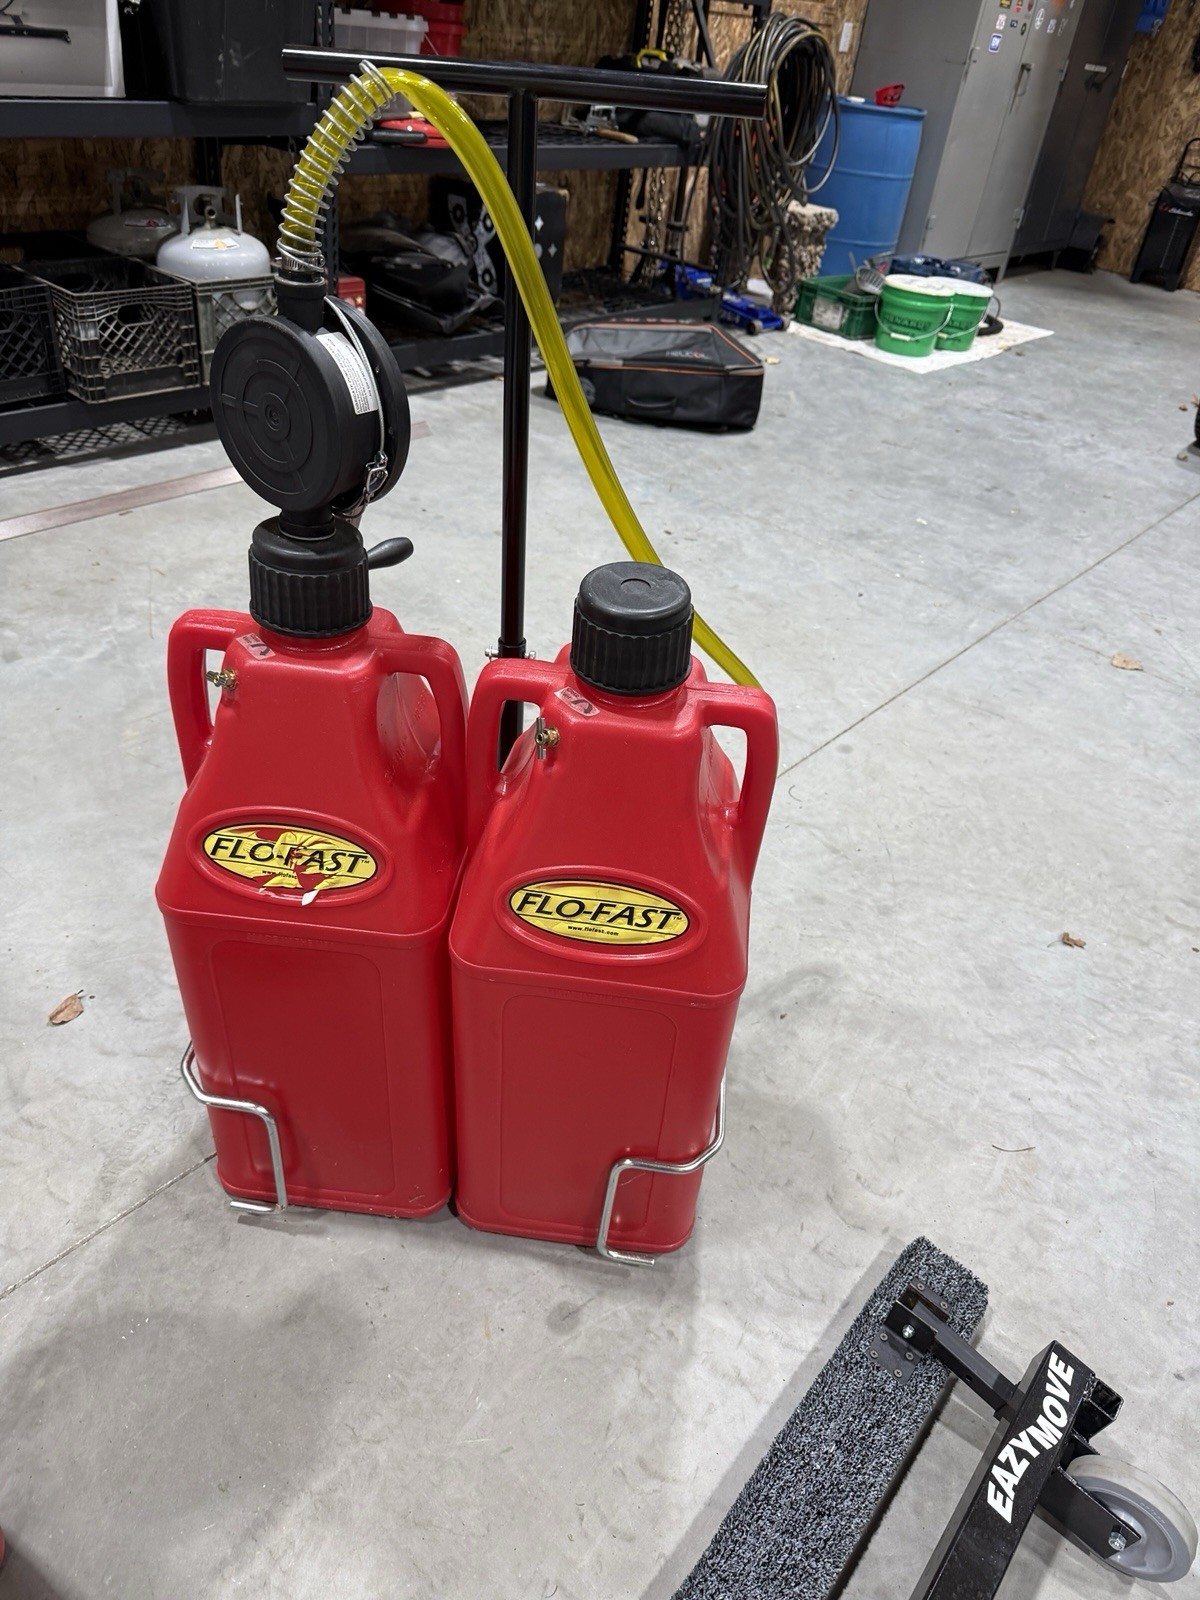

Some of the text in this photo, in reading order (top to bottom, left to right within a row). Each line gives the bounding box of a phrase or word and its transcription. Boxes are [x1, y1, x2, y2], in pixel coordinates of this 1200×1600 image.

[516, 892, 681, 930] FLO-FAST
[567, 925, 619, 936] www.flofast.com
[987, 1352, 1075, 1523] EAZYMOVE
